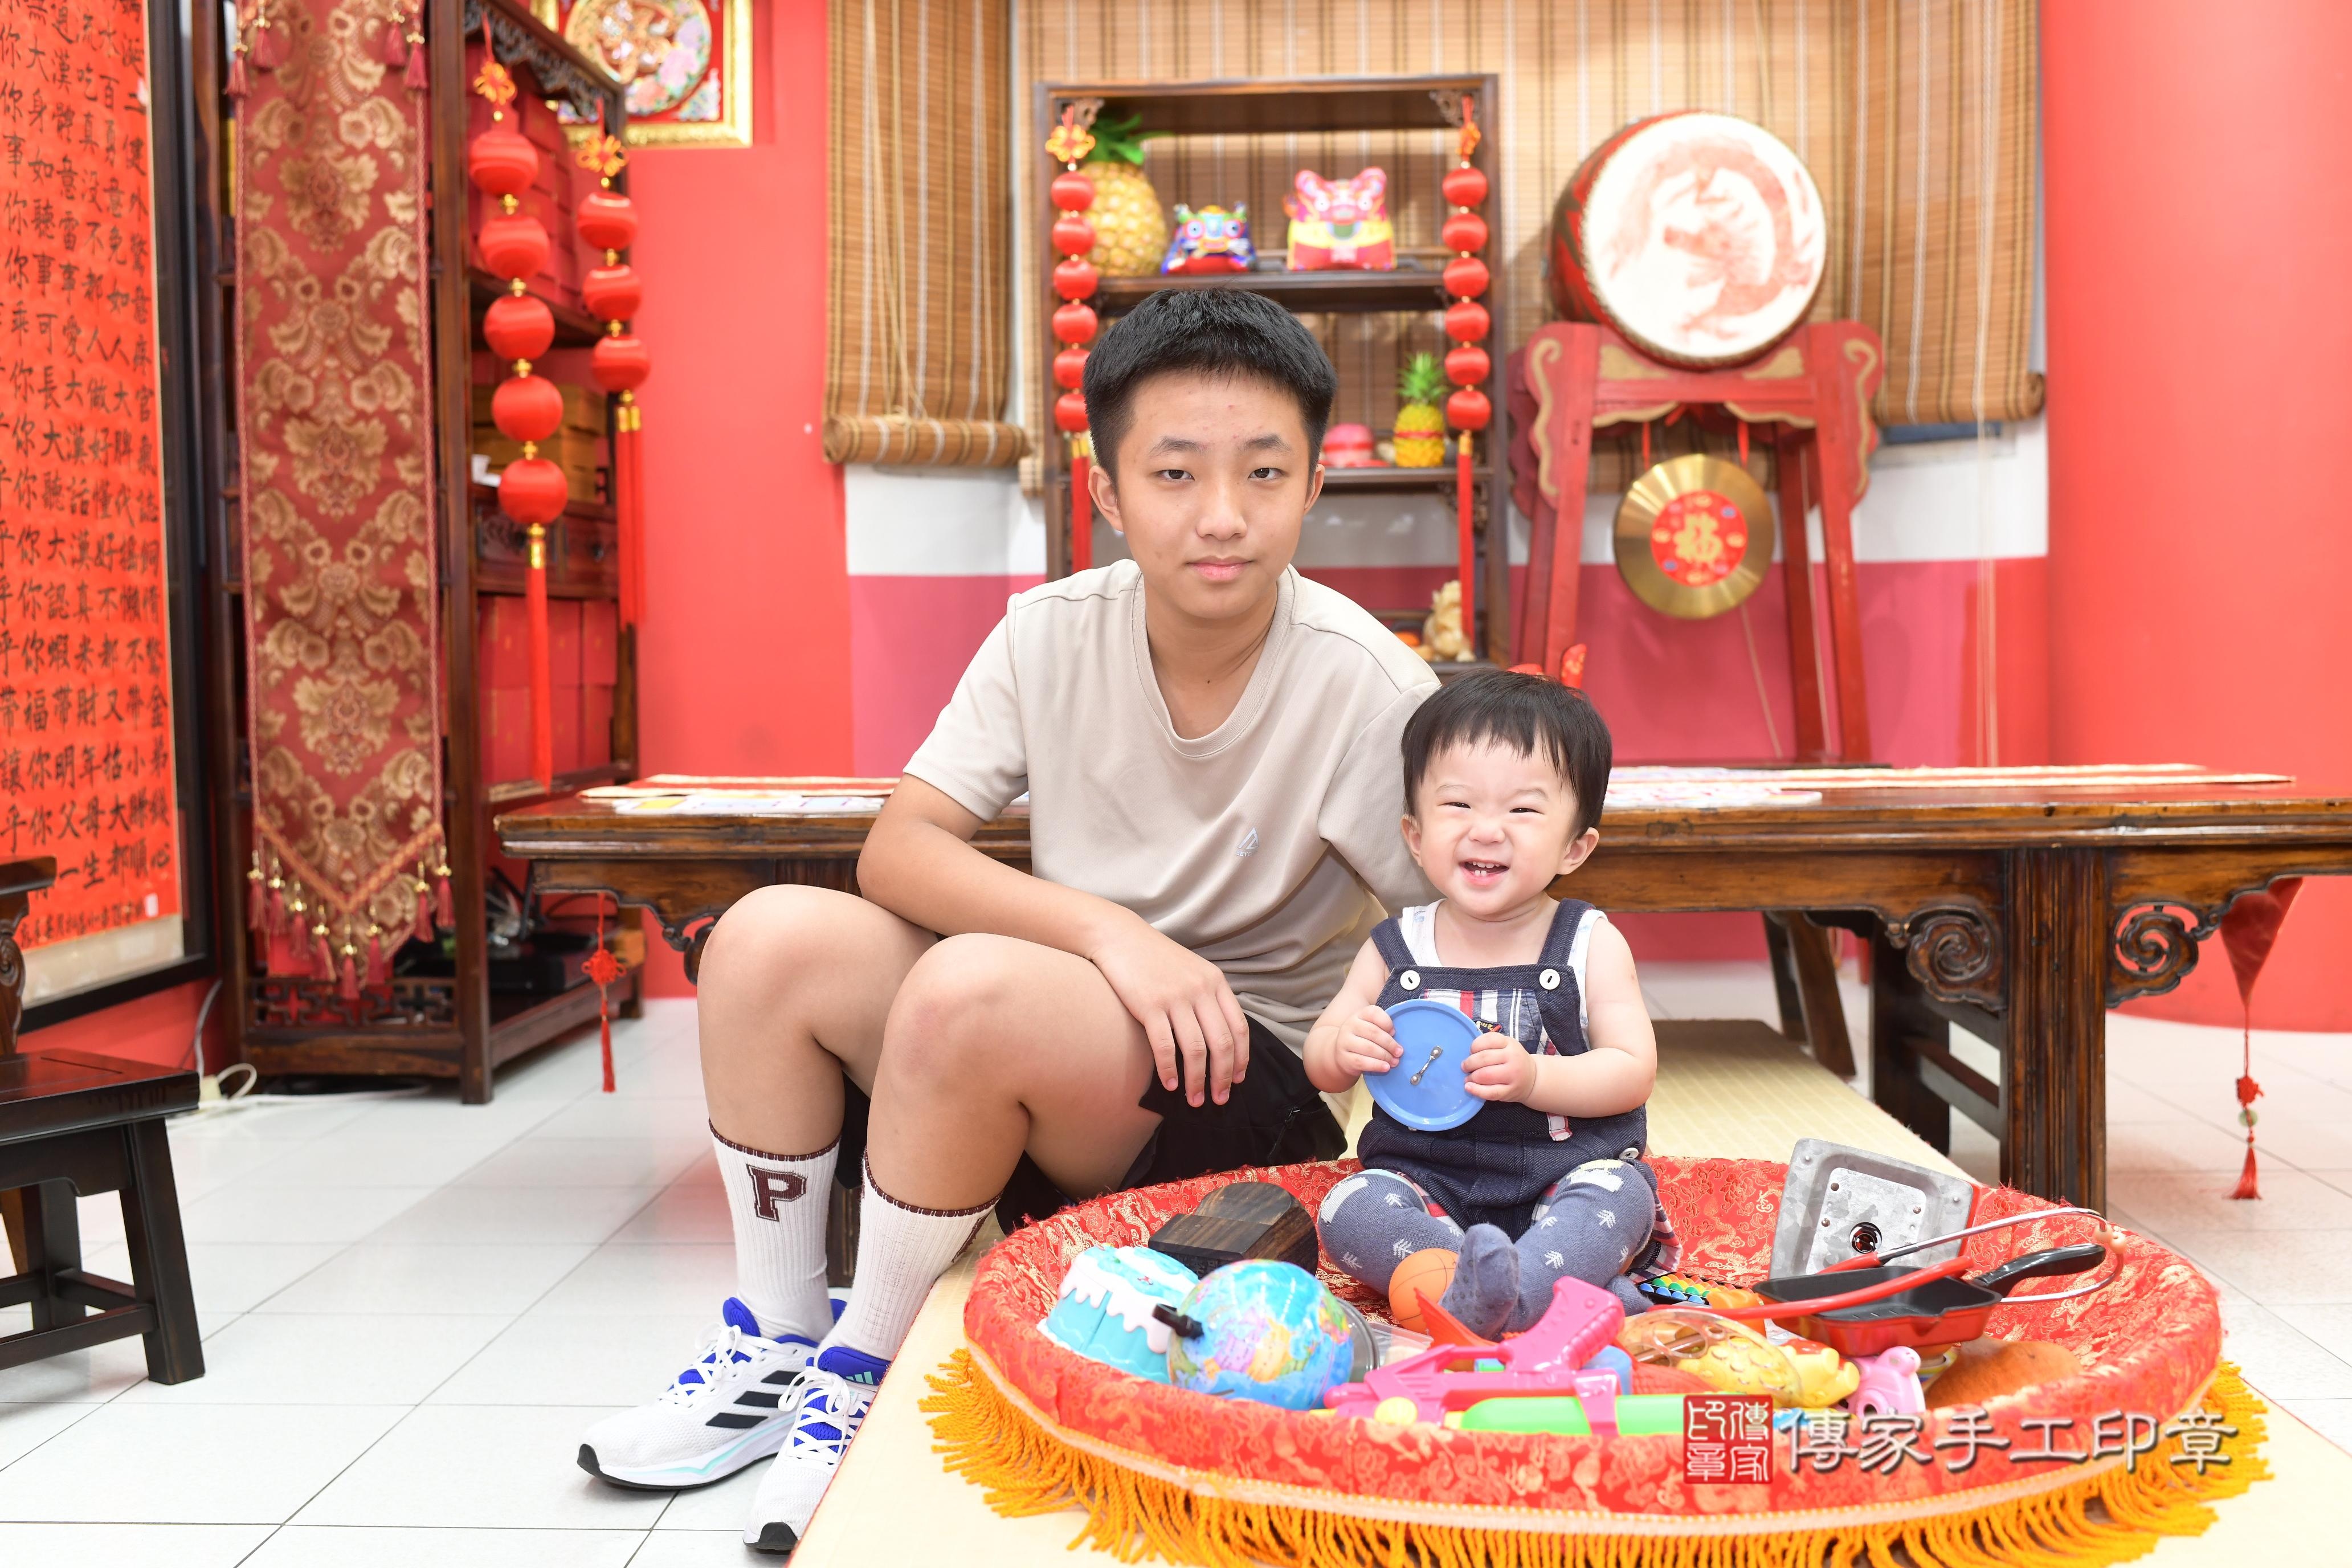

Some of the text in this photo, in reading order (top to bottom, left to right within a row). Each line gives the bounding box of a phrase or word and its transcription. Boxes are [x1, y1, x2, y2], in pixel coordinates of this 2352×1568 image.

[0, 358, 154, 422] 你長大做大官
[746, 1163, 807, 1222] P
